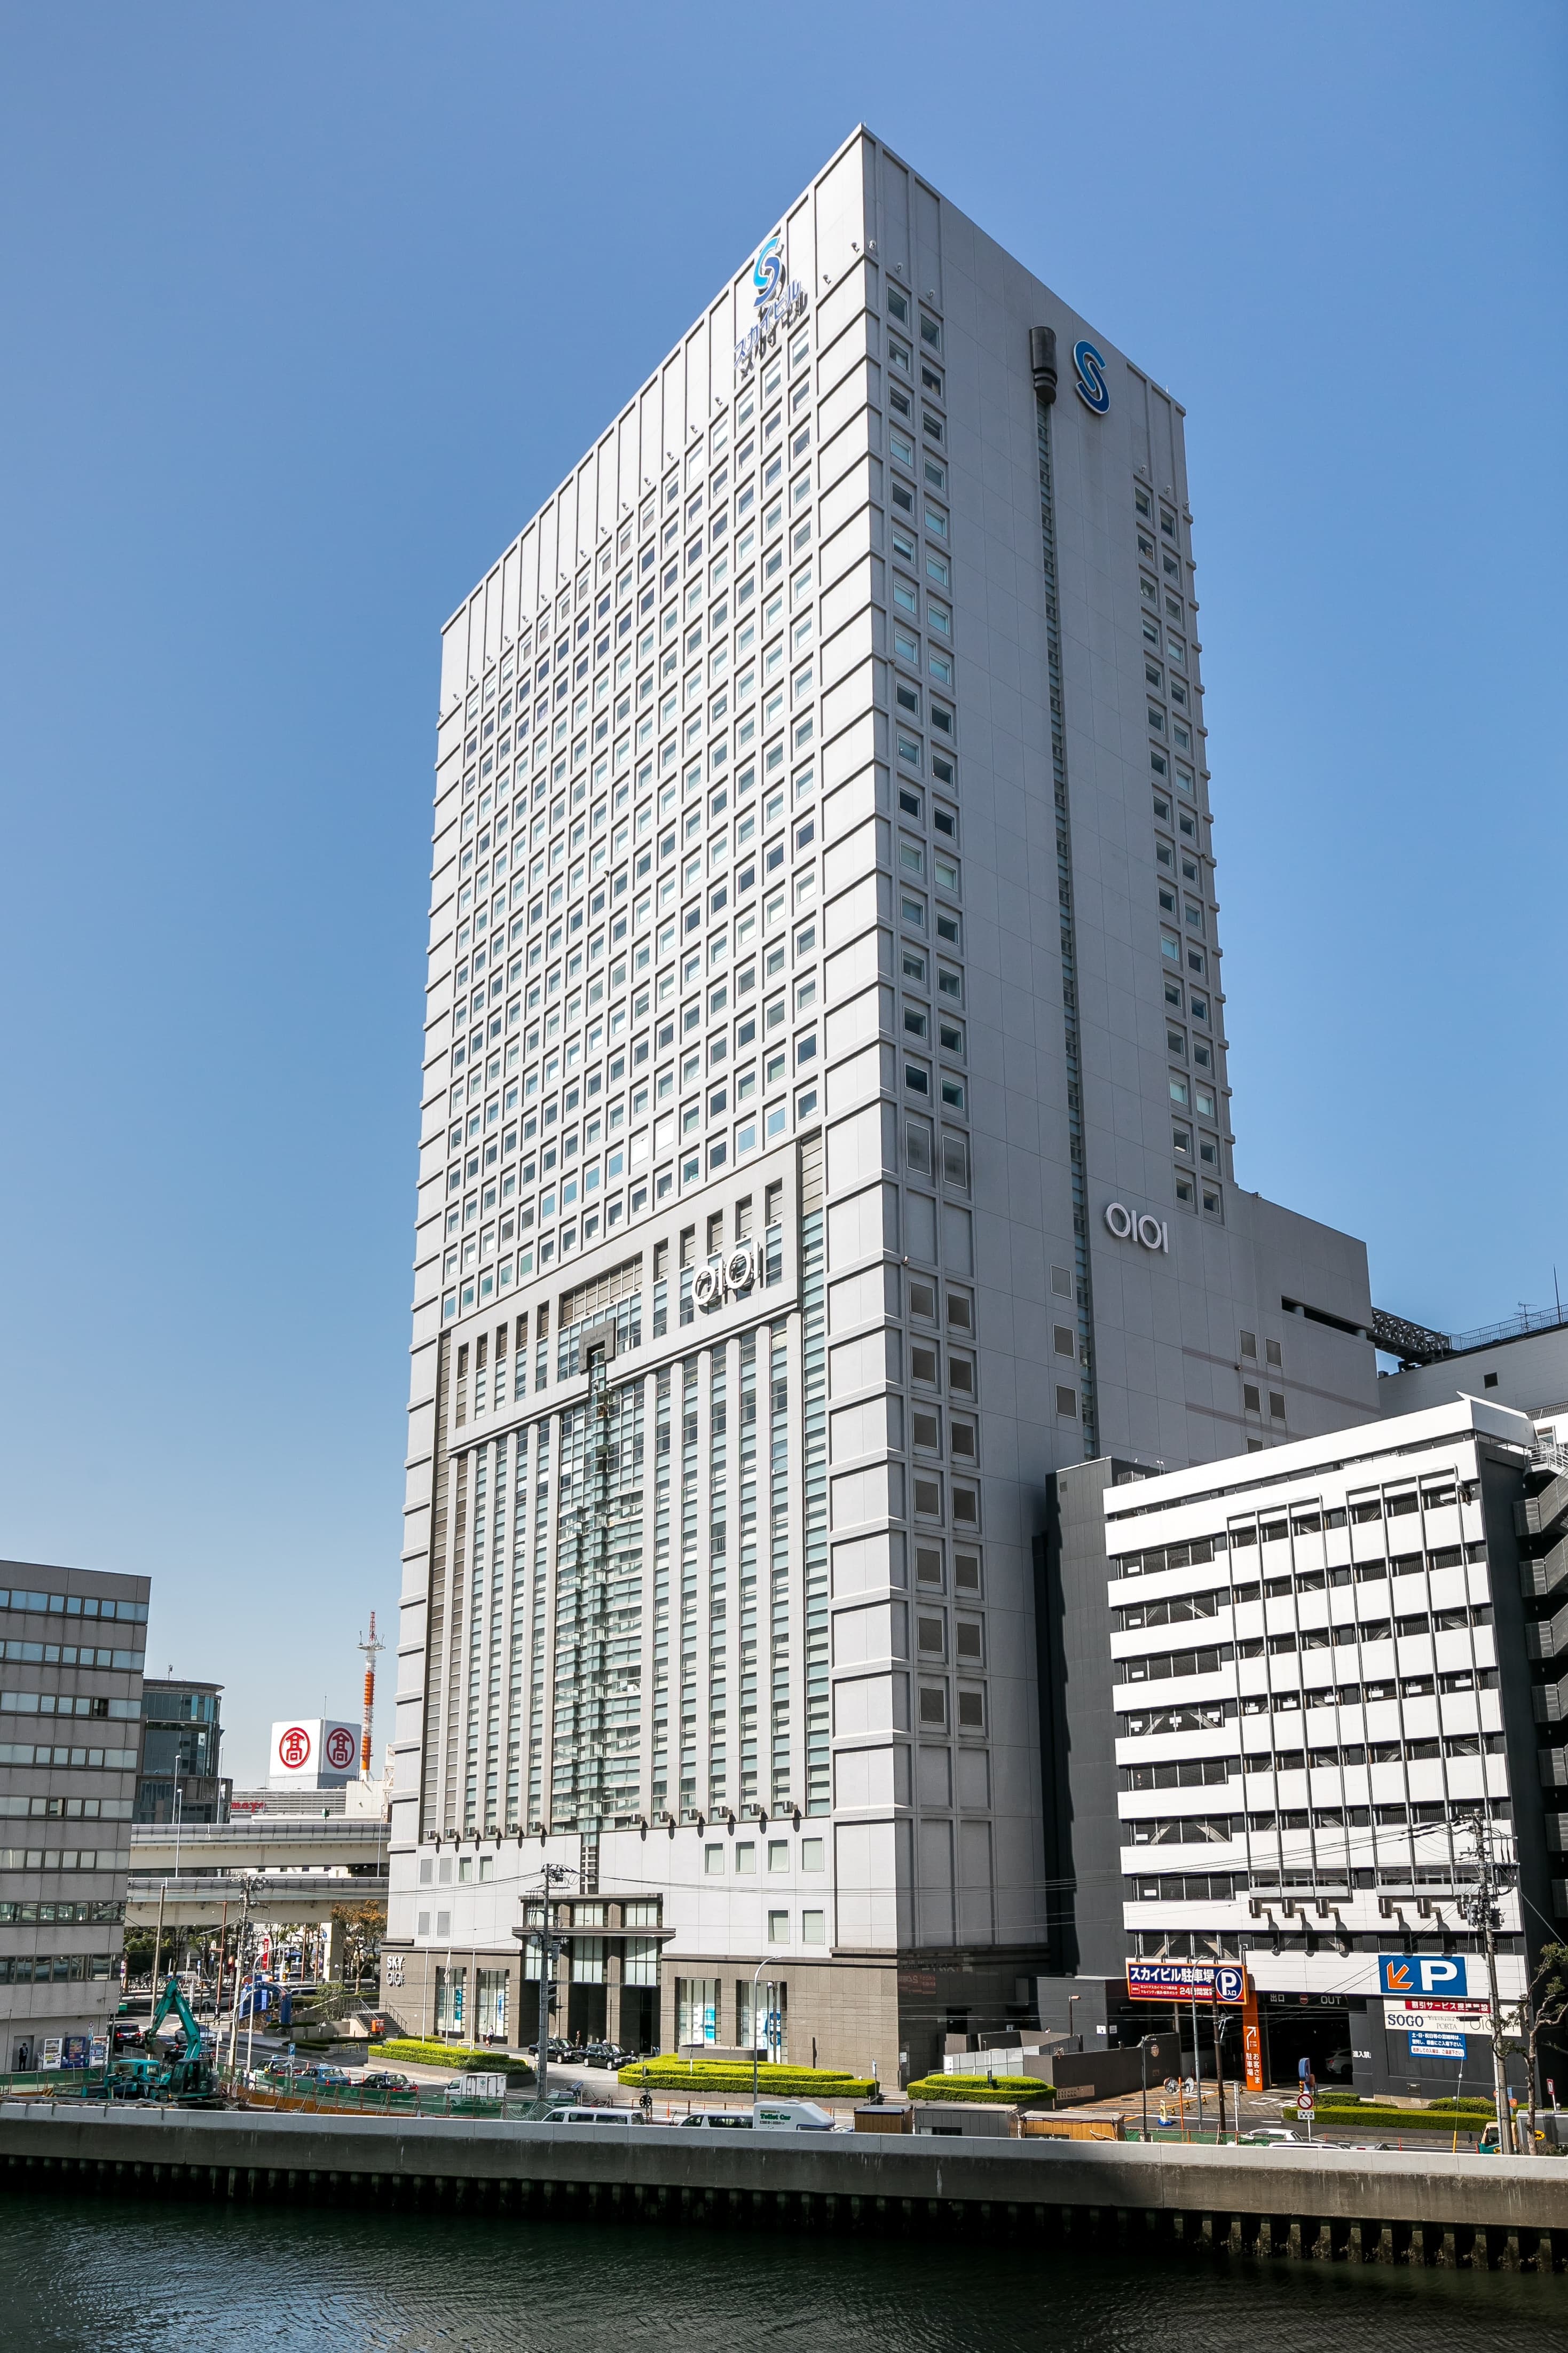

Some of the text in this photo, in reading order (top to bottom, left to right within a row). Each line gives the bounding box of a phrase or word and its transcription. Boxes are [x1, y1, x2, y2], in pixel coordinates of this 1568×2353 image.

[734, 279, 801, 368] スカイビル
[387, 1956, 404, 1969] SKY
[1131, 1967, 1215, 1983] スカイビル駐車場
[1420, 1960, 1457, 1991] P
[1222, 1972, 1237, 1996] P
[1271, 1994, 1285, 2003] 出口
[1321, 1996, 1342, 2005] OUT
[1388, 2014, 1424, 2027] SOGO
[290, 2045, 294, 2055] P
